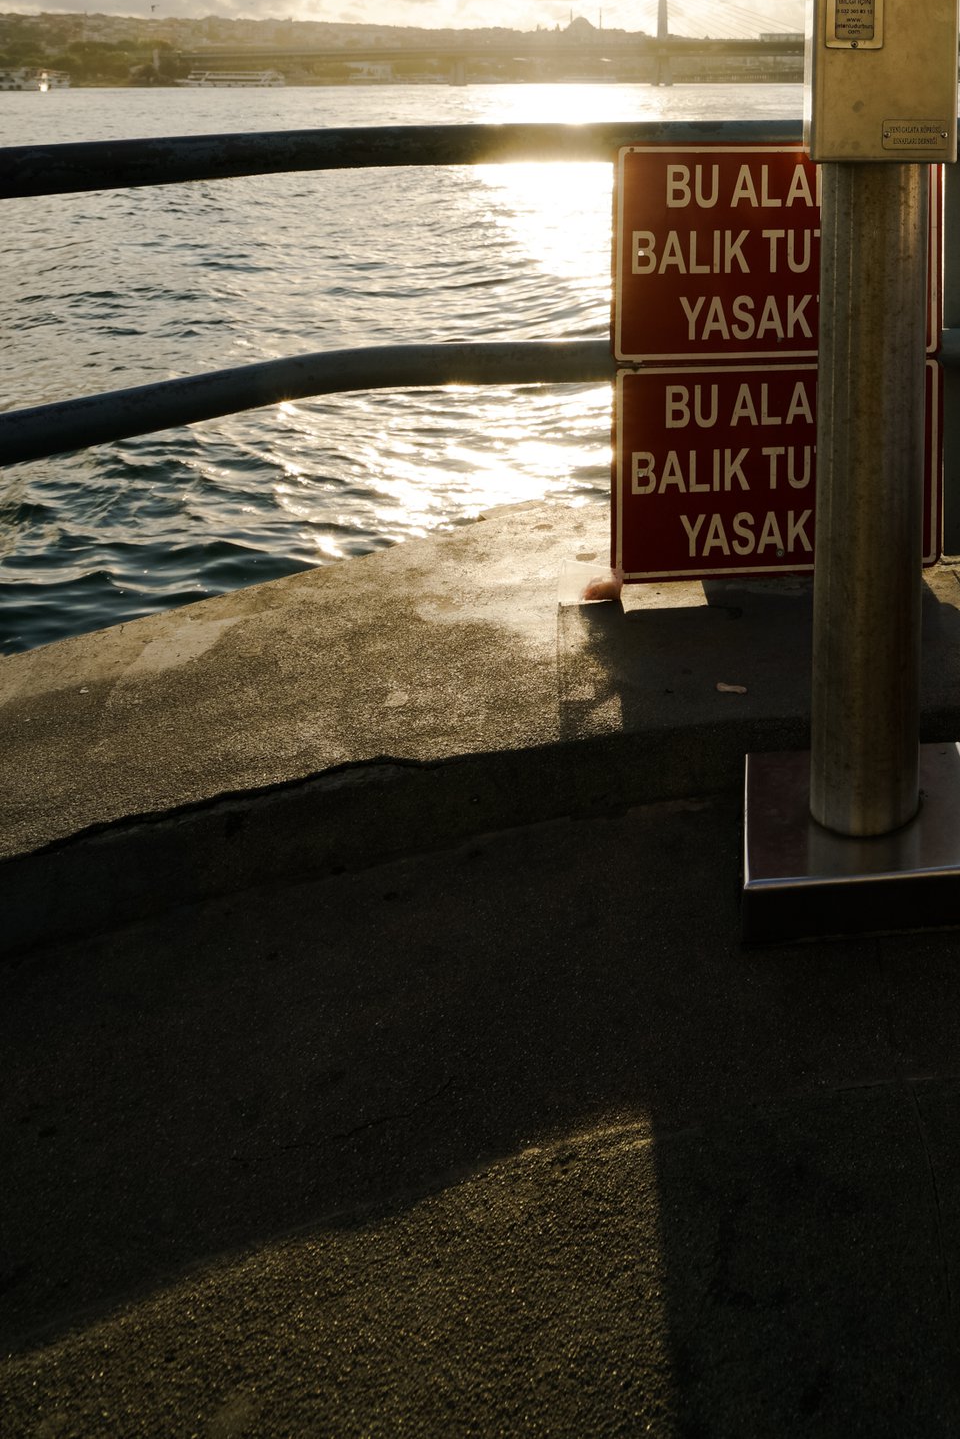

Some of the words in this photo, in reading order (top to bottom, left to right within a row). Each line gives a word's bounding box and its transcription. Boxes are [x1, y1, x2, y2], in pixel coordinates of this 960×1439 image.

[666, 164, 719, 208] BU
[730, 164, 822, 208] ALA
[632, 230, 750, 275] BALIK
[679, 294, 820, 341] YASAK
[665, 384, 718, 429] BU
[730, 381, 818, 427] ALA
[631, 448, 750, 495] BALIK
[762, 445, 817, 490] TU
